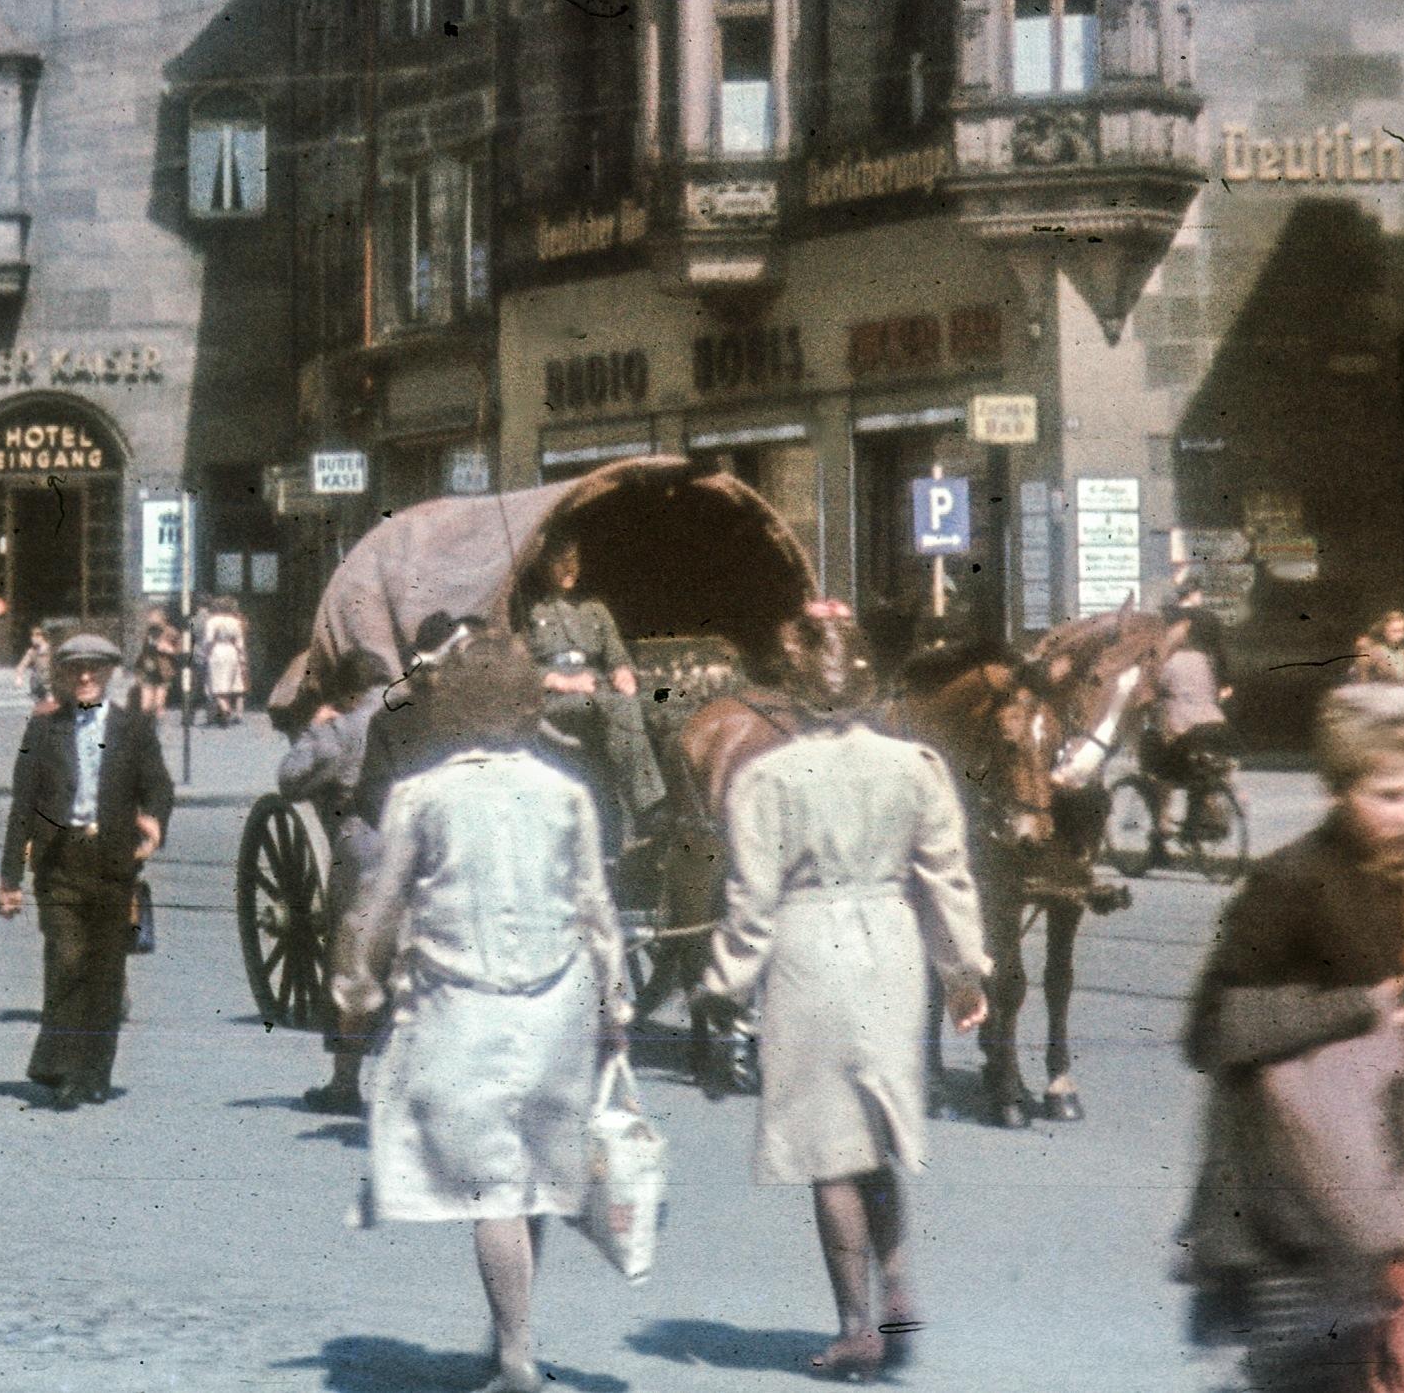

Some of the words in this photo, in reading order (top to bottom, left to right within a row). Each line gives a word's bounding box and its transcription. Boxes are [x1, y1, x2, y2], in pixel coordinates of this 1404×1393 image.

[50, 345, 164, 382] KAISER
[5, 425, 95, 448] HOTEL
[929, 487, 952, 529] P
